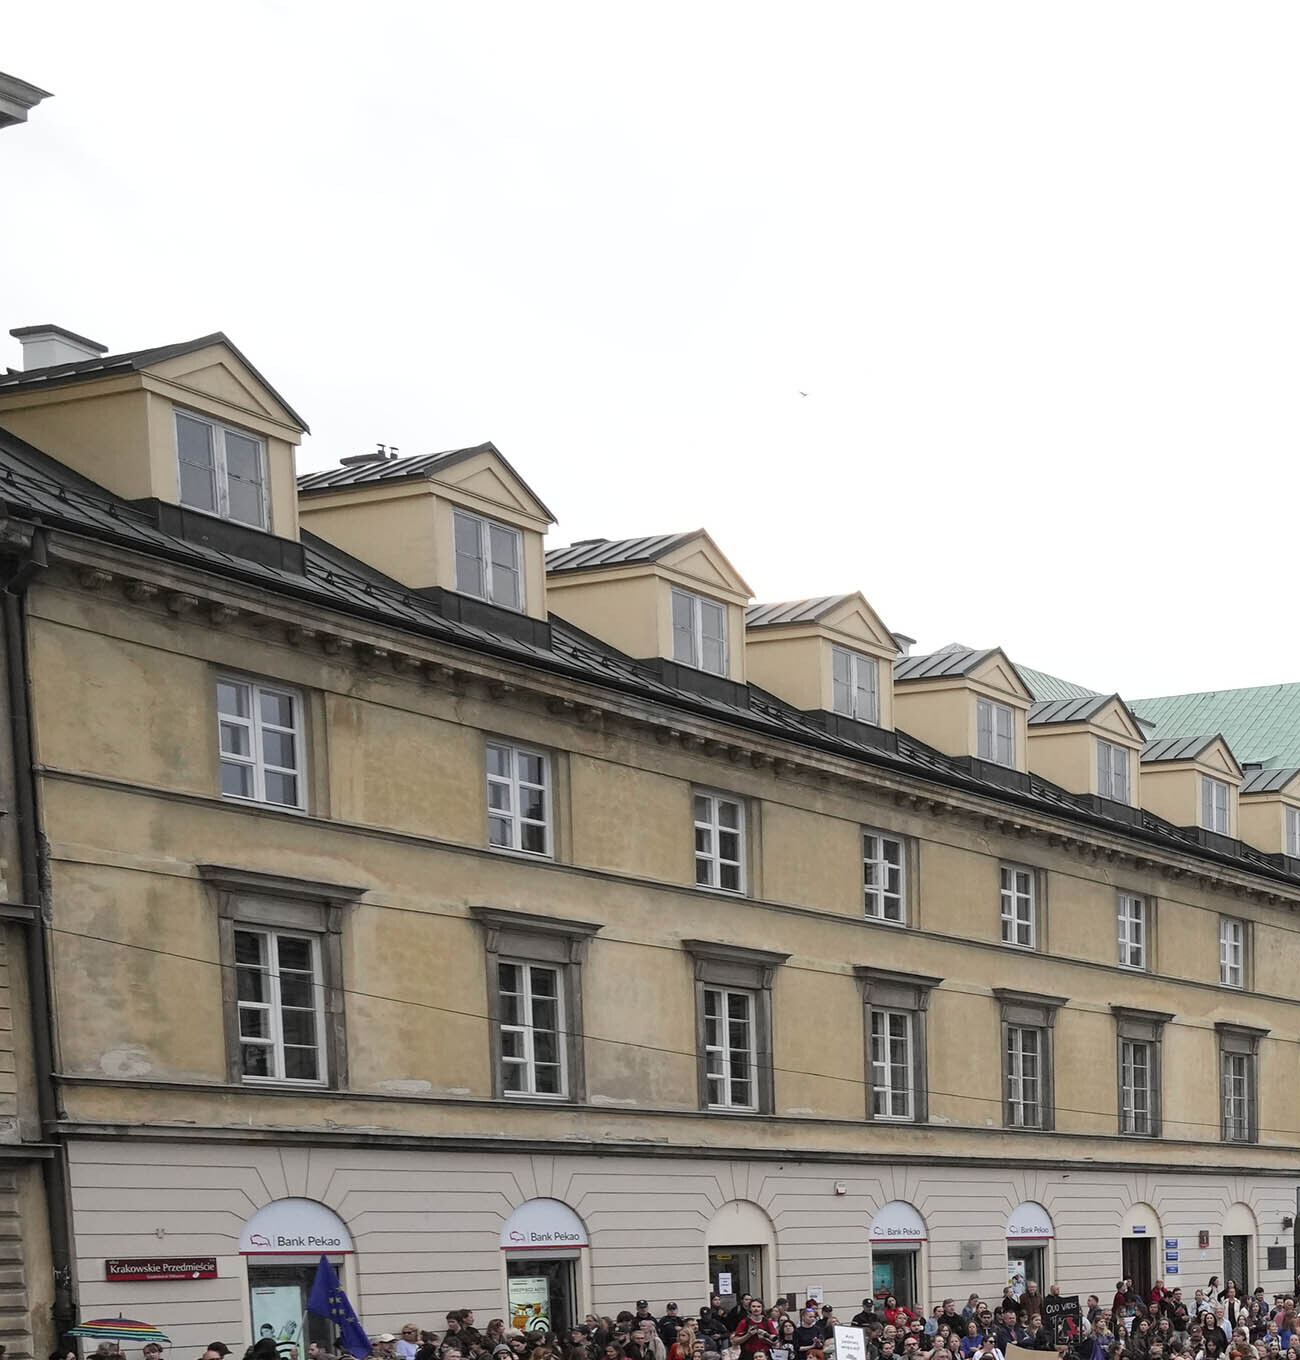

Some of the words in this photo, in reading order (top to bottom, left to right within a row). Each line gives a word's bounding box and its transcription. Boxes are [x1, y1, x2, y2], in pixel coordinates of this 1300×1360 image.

[887, 1227, 900, 1236] Bank
[278, 1236, 305, 1246] Bank
[308, 1236, 340, 1247] Pekao
[531, 1232, 552, 1242] Bank
[554, 1232, 580, 1241] Pekao
[110, 1264, 161, 1274] Krakowskie
[162, 1262, 215, 1272] Przedmieście
